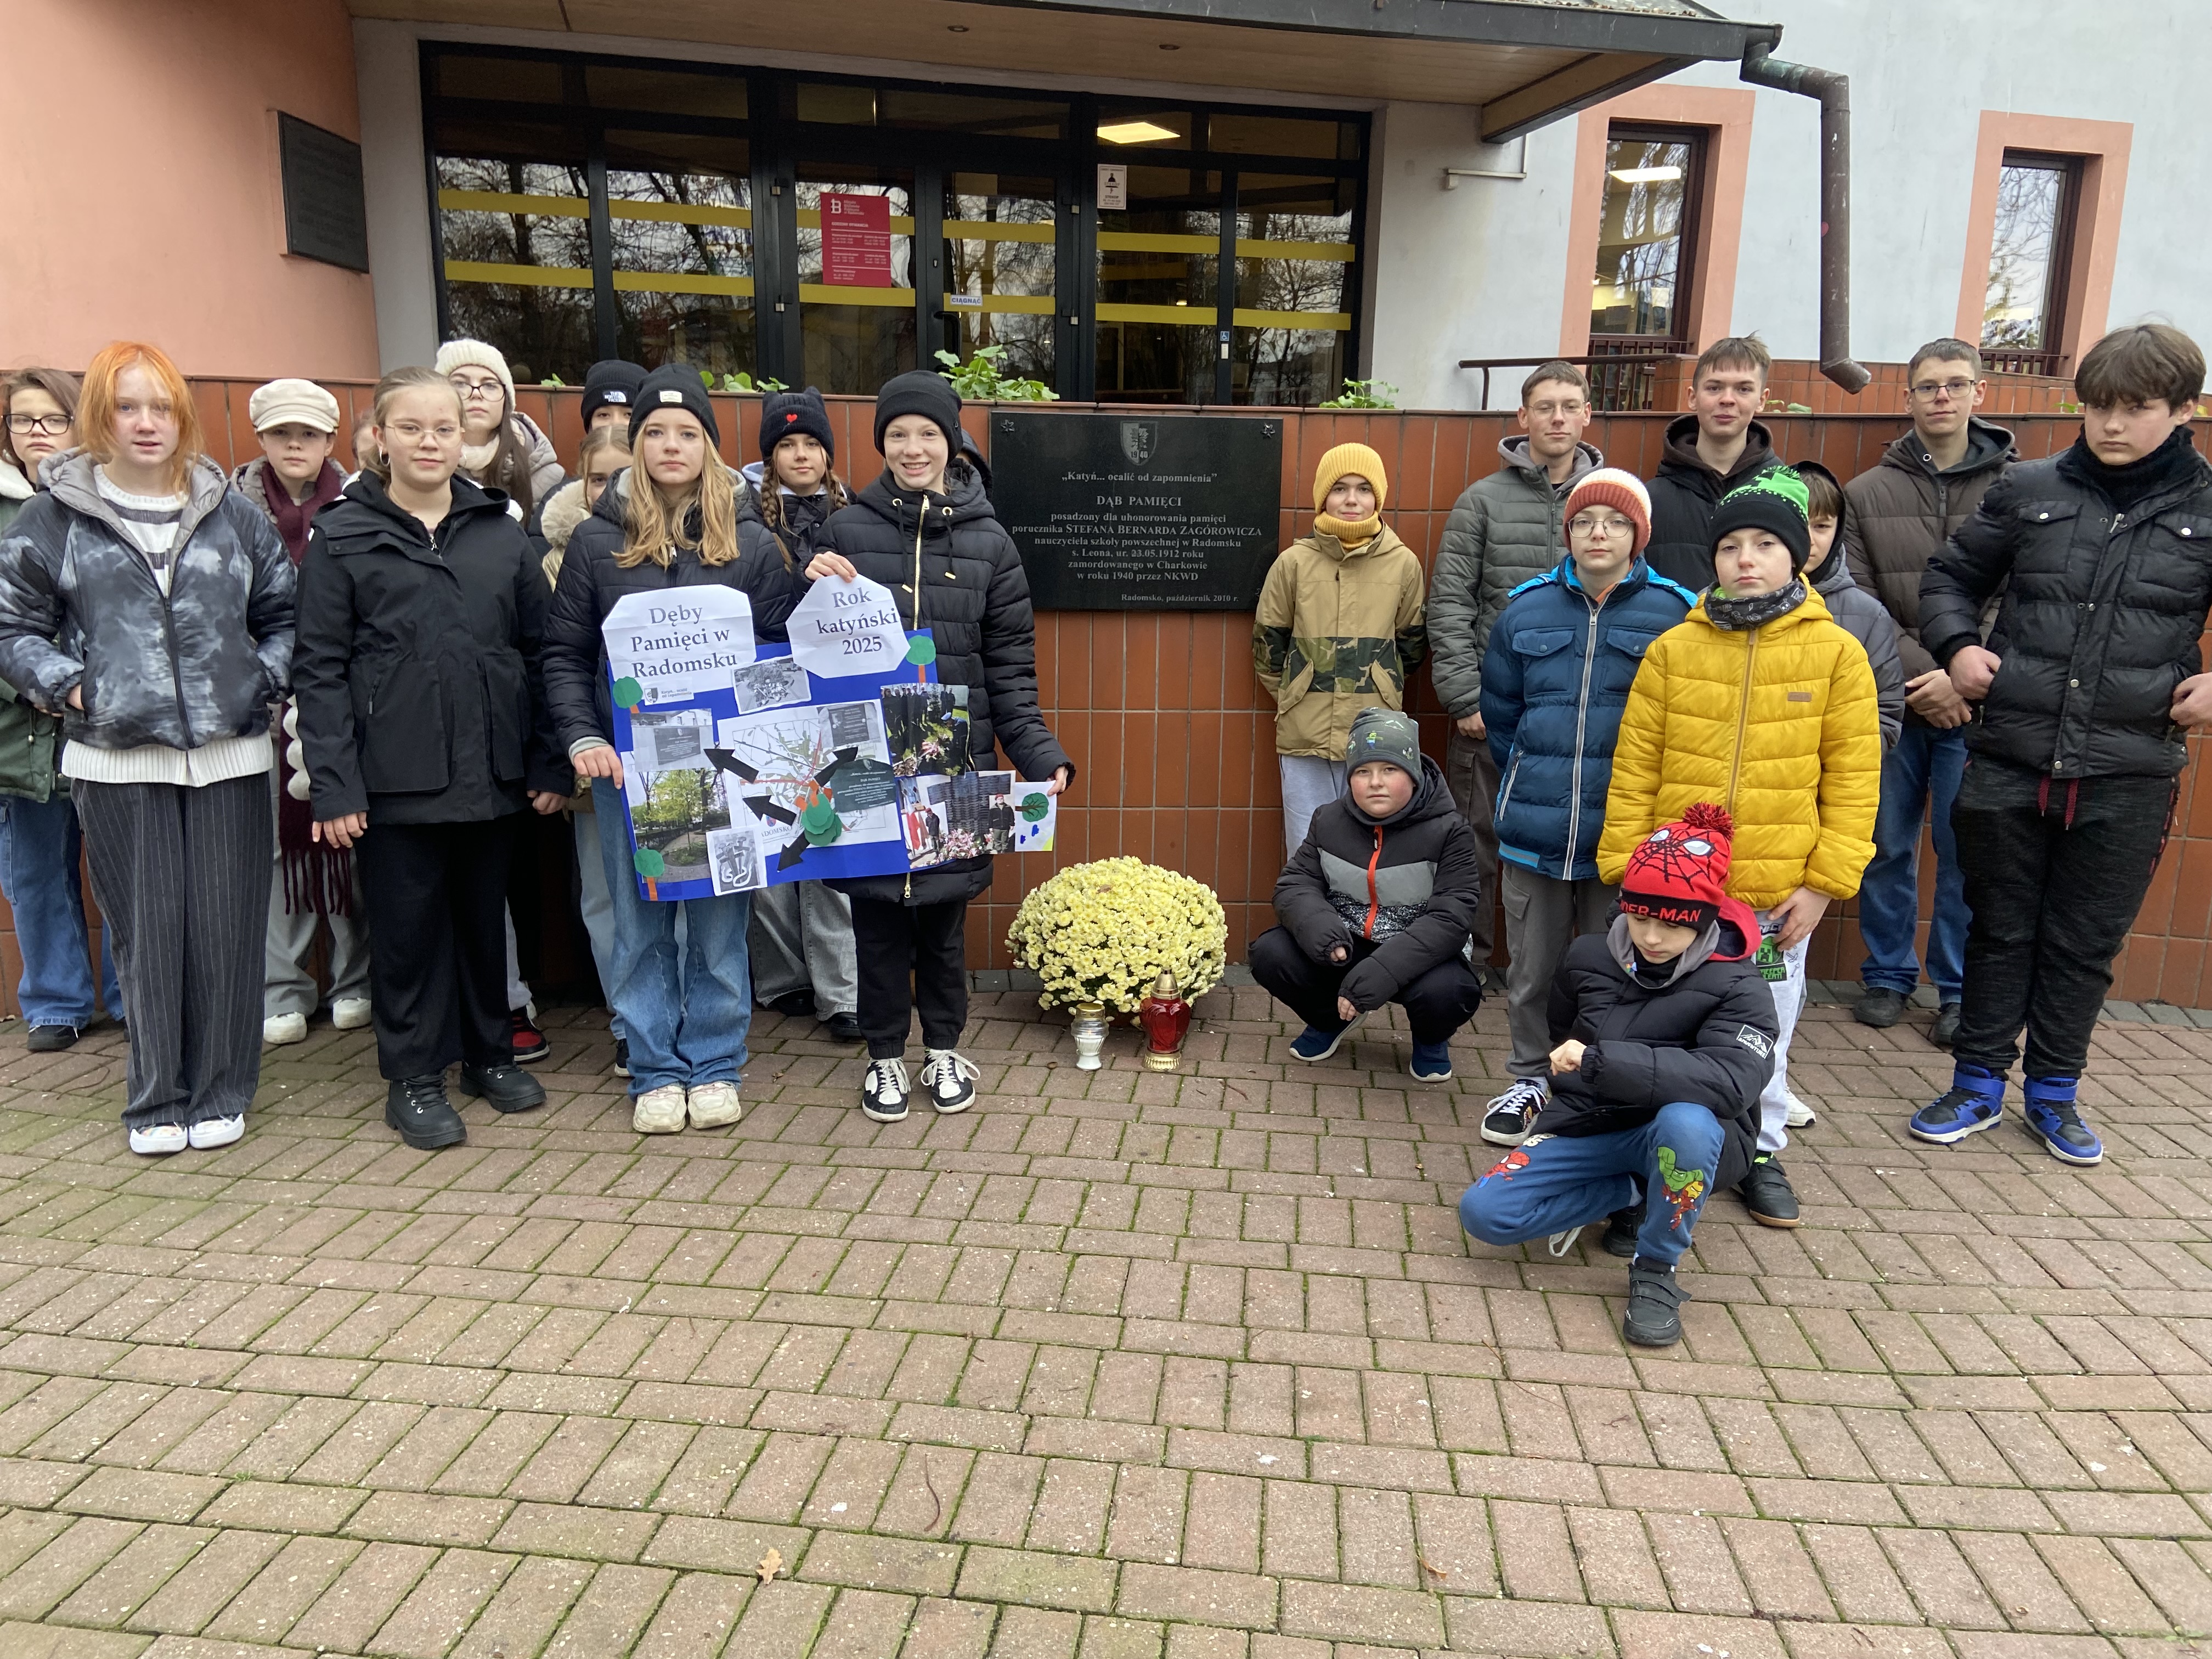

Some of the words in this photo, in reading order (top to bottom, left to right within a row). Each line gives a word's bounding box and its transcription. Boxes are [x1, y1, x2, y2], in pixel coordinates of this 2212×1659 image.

[1108, 472, 1135, 481] ocalić
[1138, 473, 1149, 481] od
[1097, 495, 1122, 507] DĄB
[1129, 496, 1182, 508] PAMIĘCI
[1051, 512, 1101, 522] posadzony
[1103, 513, 1118, 521] dla
[1121, 514, 1187, 522] uhonorowania
[1190, 515, 1226, 524] pamięci
[1012, 524, 1063, 534] porucznika
[1066, 524, 1114, 533] STEFANA
[1118, 525, 1177, 534] BERNARDA
[1180, 524, 1262, 536] ZAGÓROWICZA
[1035, 537, 1088, 546] nauczyciela
[1122, 538, 1180, 548] powszechnej
[1192, 539, 1241, 547] Radomsku
[1082, 549, 1114, 558] Leona,
[1182, 550, 1204, 558] roku
[1068, 560, 1144, 570] zamordowanego
[1156, 561, 1207, 569] Charkowie
[1113, 572, 1134, 580] 1940
[1136, 573, 1162, 582] przez
[1164, 572, 1199, 580] NKWD
[832, 587, 872, 608] Rok
[1166, 594, 1211, 602] październik
[648, 605, 703, 627] Dęby
[815, 608, 899, 635] katyński
[630, 628, 709, 652] Pamięci
[713, 629, 730, 641] w
[842, 636, 882, 655] 2025
[631, 652, 737, 678] Radomsku
[761, 825, 793, 837] DOMSKO
